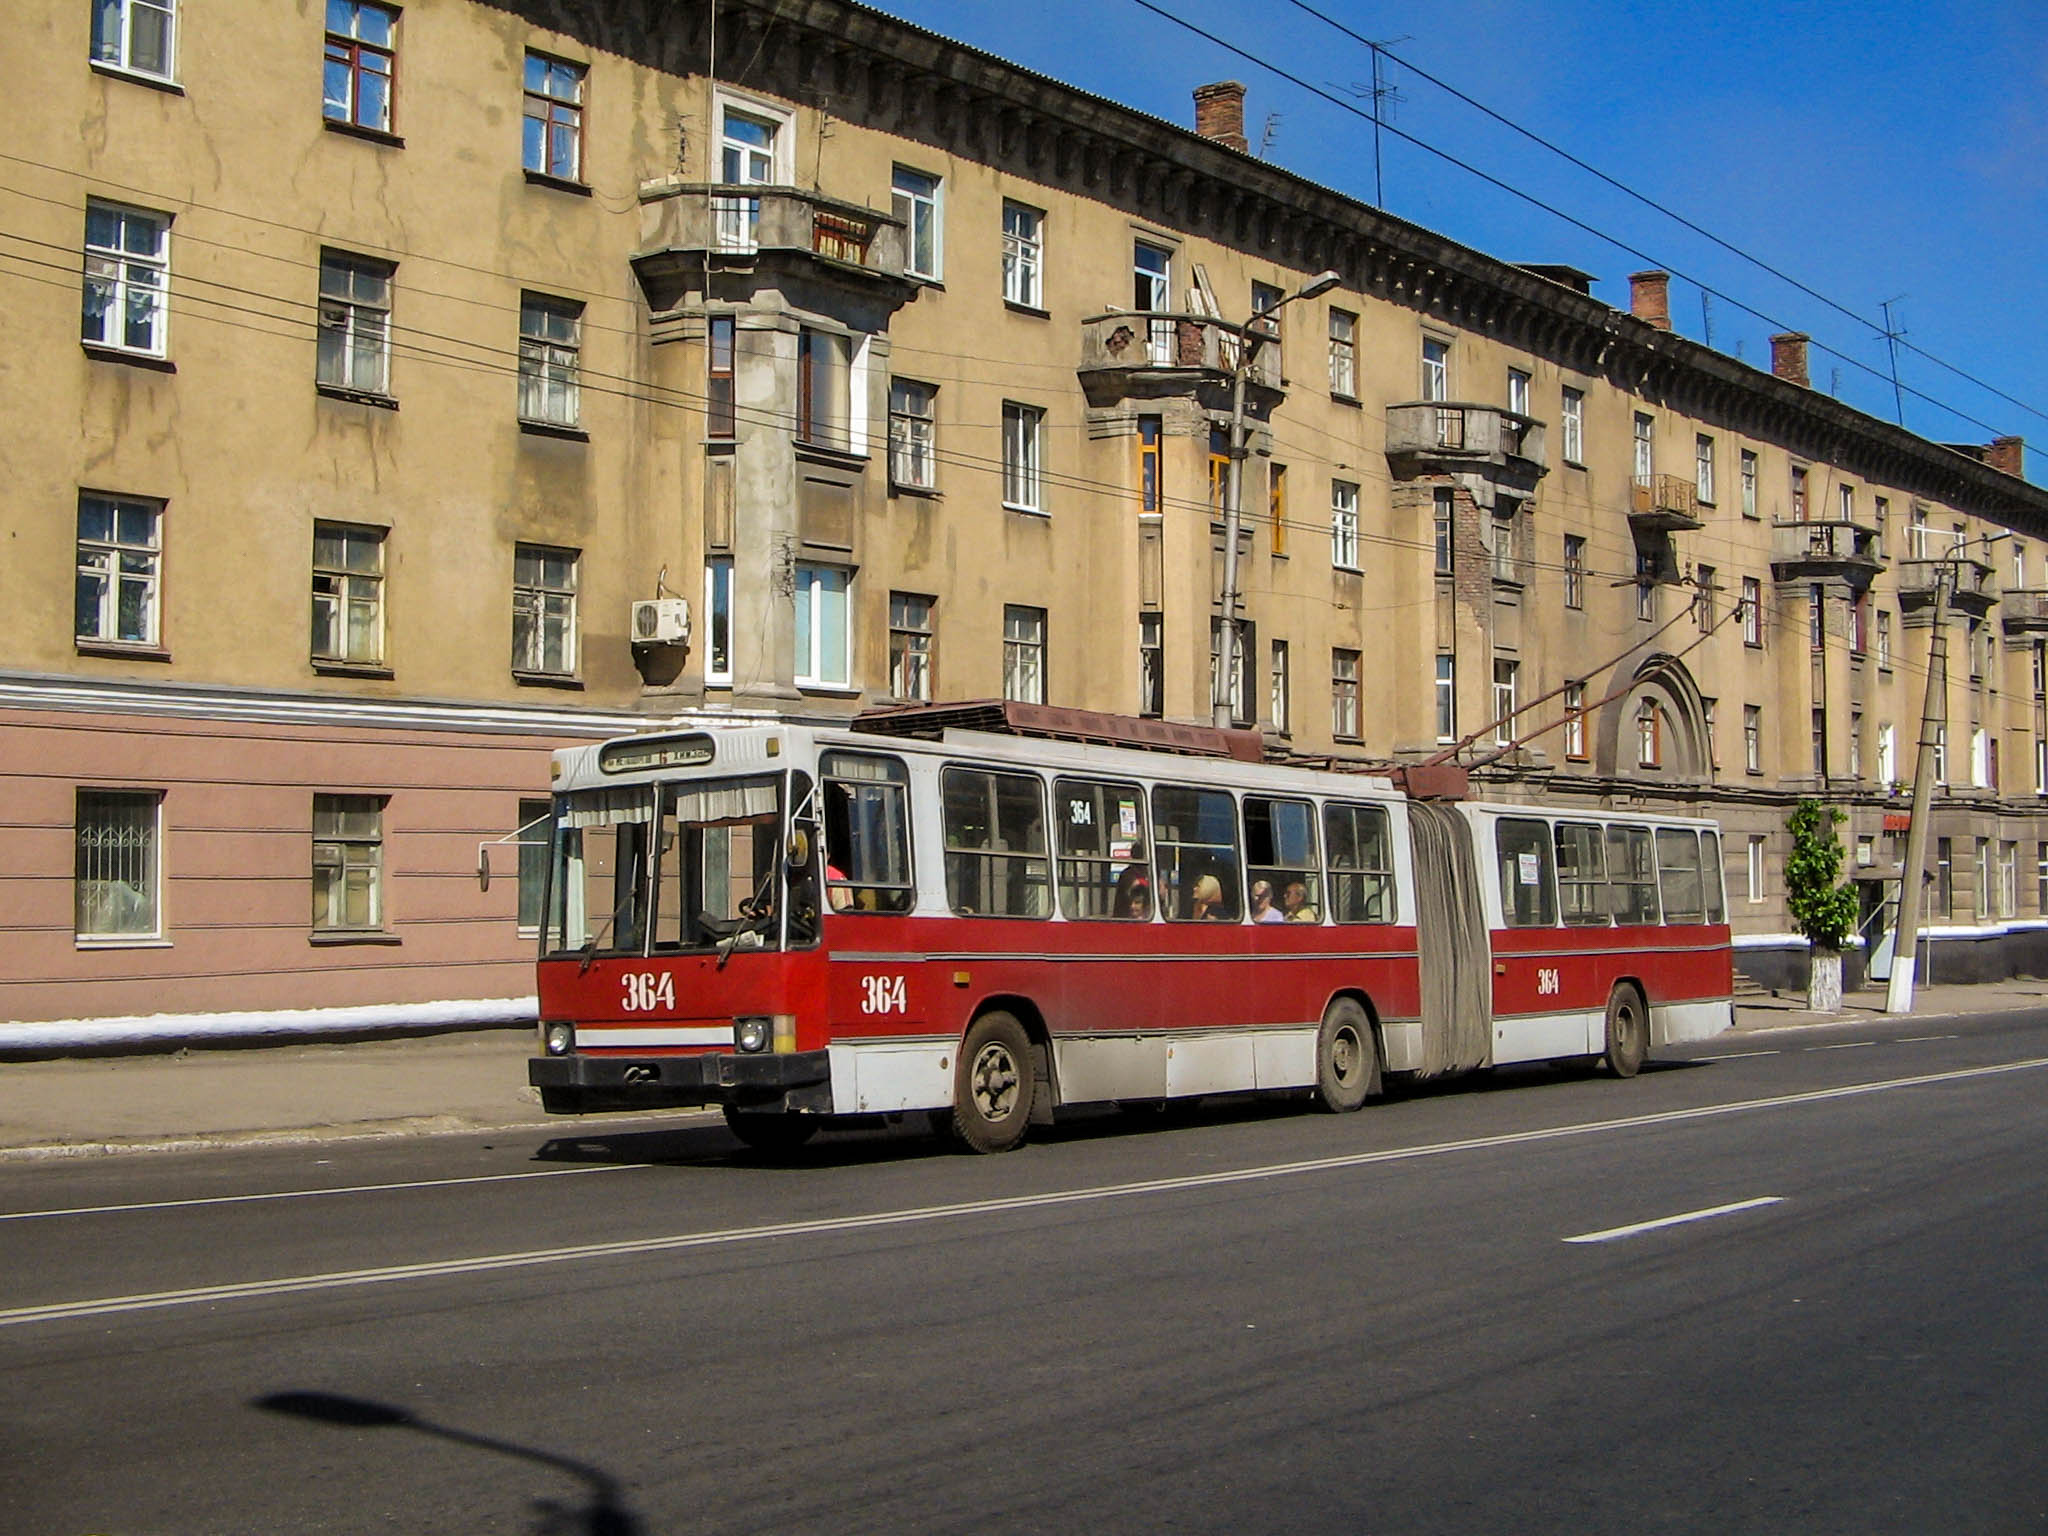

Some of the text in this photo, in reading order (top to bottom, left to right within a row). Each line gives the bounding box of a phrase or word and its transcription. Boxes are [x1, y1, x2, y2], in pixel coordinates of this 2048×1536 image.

[1070, 800, 1091, 825] 364
[621, 972, 675, 1012] 364
[861, 975, 907, 1014] 364
[1538, 968, 1560, 995] 364
